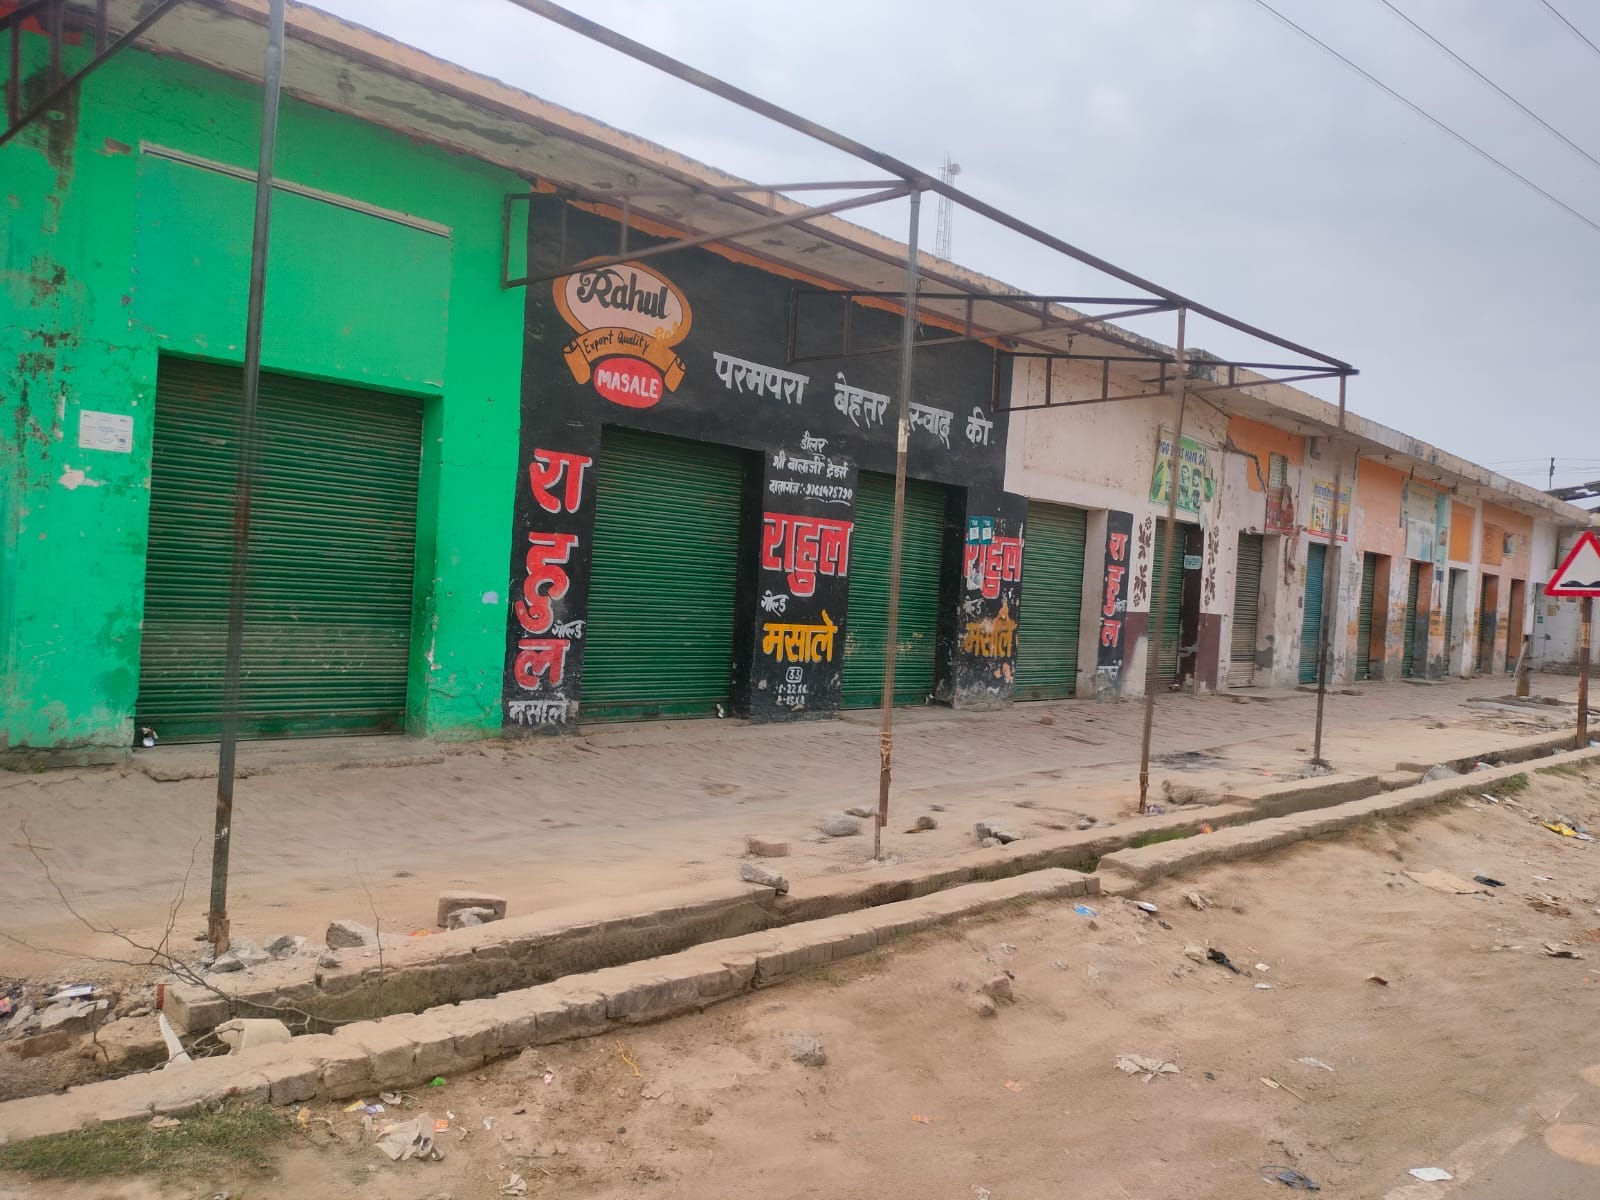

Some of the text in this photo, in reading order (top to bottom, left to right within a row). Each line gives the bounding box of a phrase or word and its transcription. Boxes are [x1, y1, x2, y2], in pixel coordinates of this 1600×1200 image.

[577, 269, 672, 320] Rahul
[583, 330, 650, 355] Export Quality
[597, 369, 660, 399] MASALE
[713, 352, 810, 405] परमपरा
[834, 371, 891, 428] बेहतर
[966, 407, 994, 447] की
[773, 450, 787, 470] श्री
[800, 430, 829, 453] डीलर
[513, 448, 592, 690] राहुल
[762, 511, 854, 597] राहुल
[762, 609, 838, 663] मसाले
